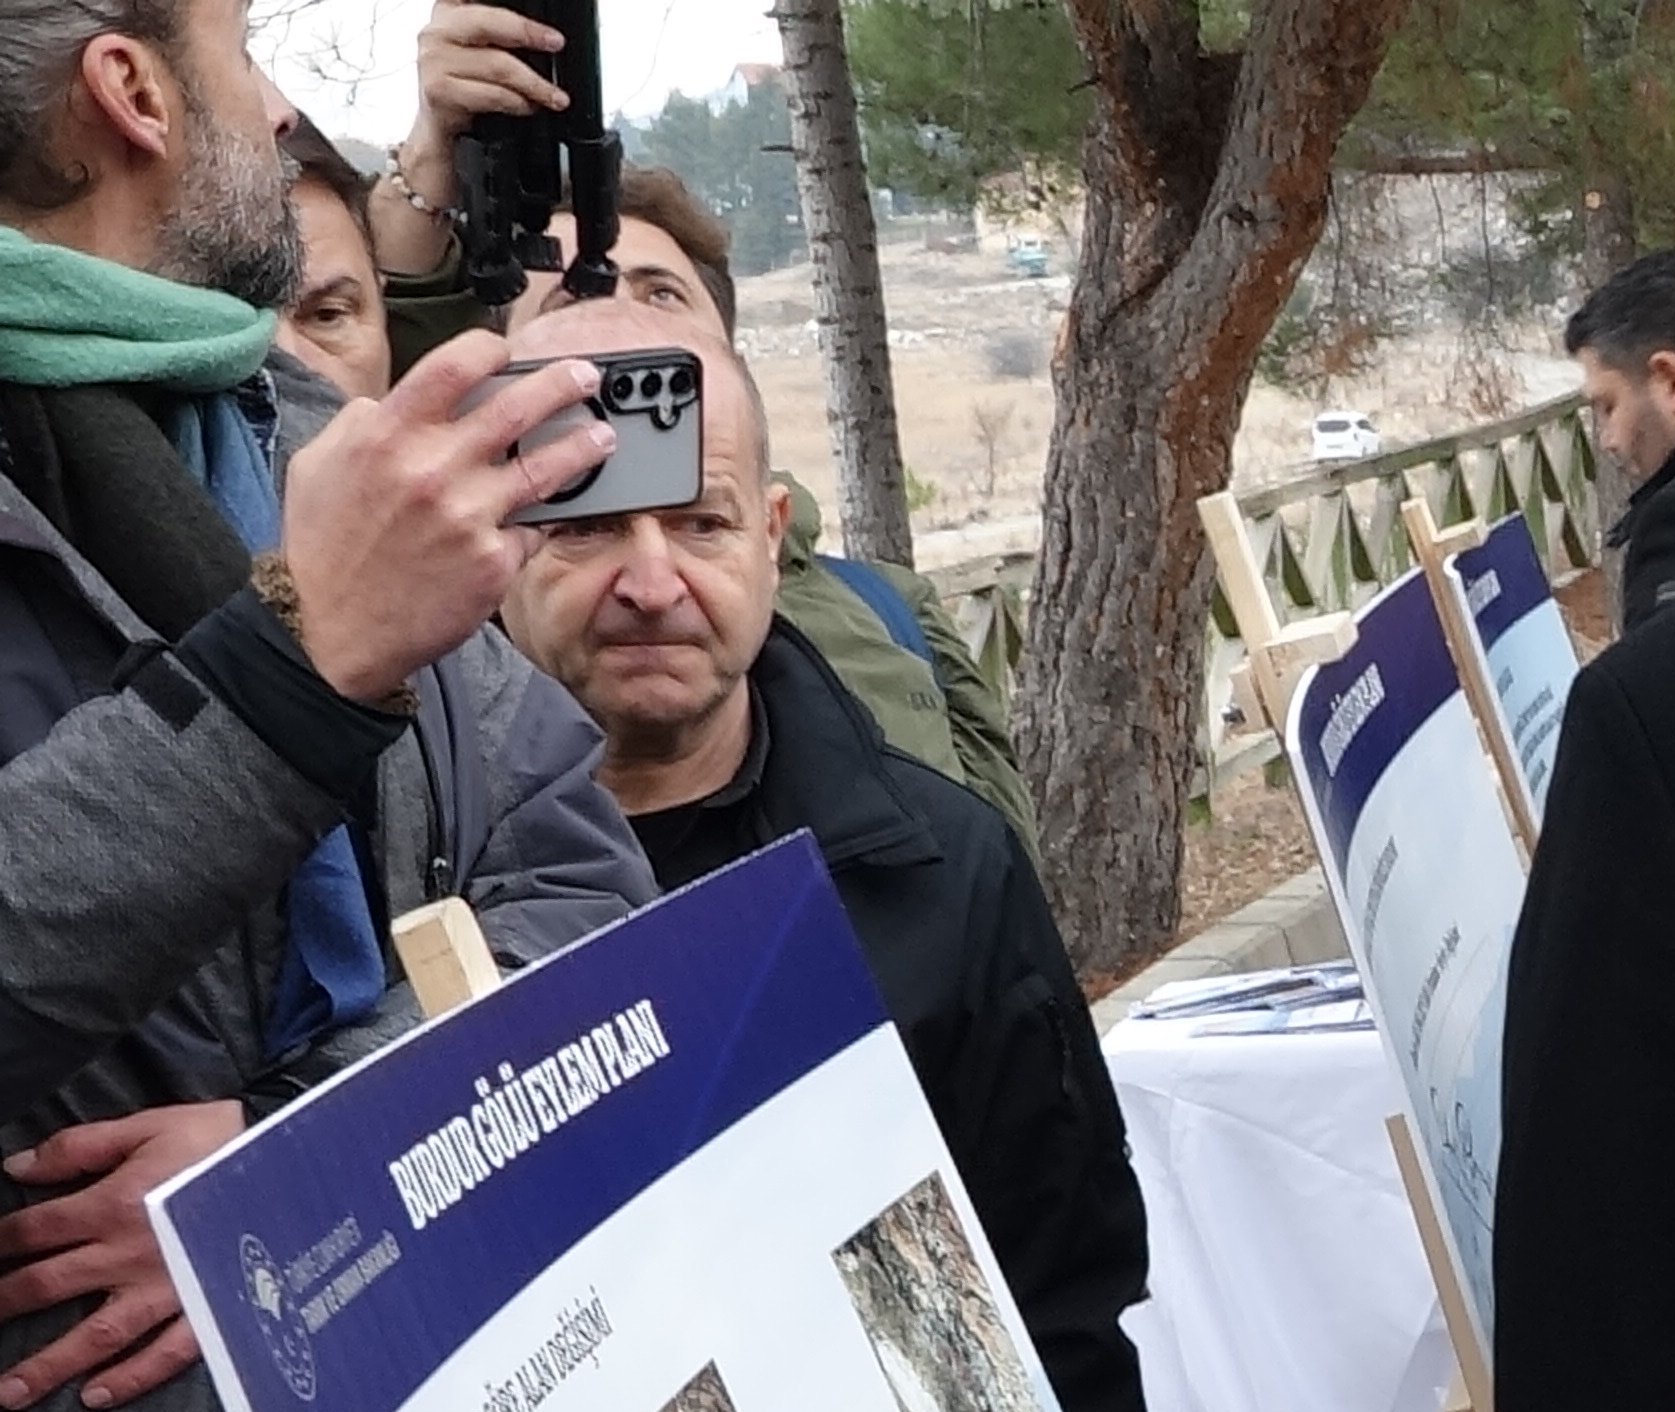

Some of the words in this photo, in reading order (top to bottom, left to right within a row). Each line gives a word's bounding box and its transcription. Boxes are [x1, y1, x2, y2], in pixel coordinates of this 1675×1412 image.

[389, 1117, 491, 1230] BURDUR
[471, 1059, 539, 1168] GÖLÜ
[521, 1030, 610, 1133] EYLEM
[592, 1000, 670, 1086] PLANI
[515, 1354, 556, 1412] ALAN
